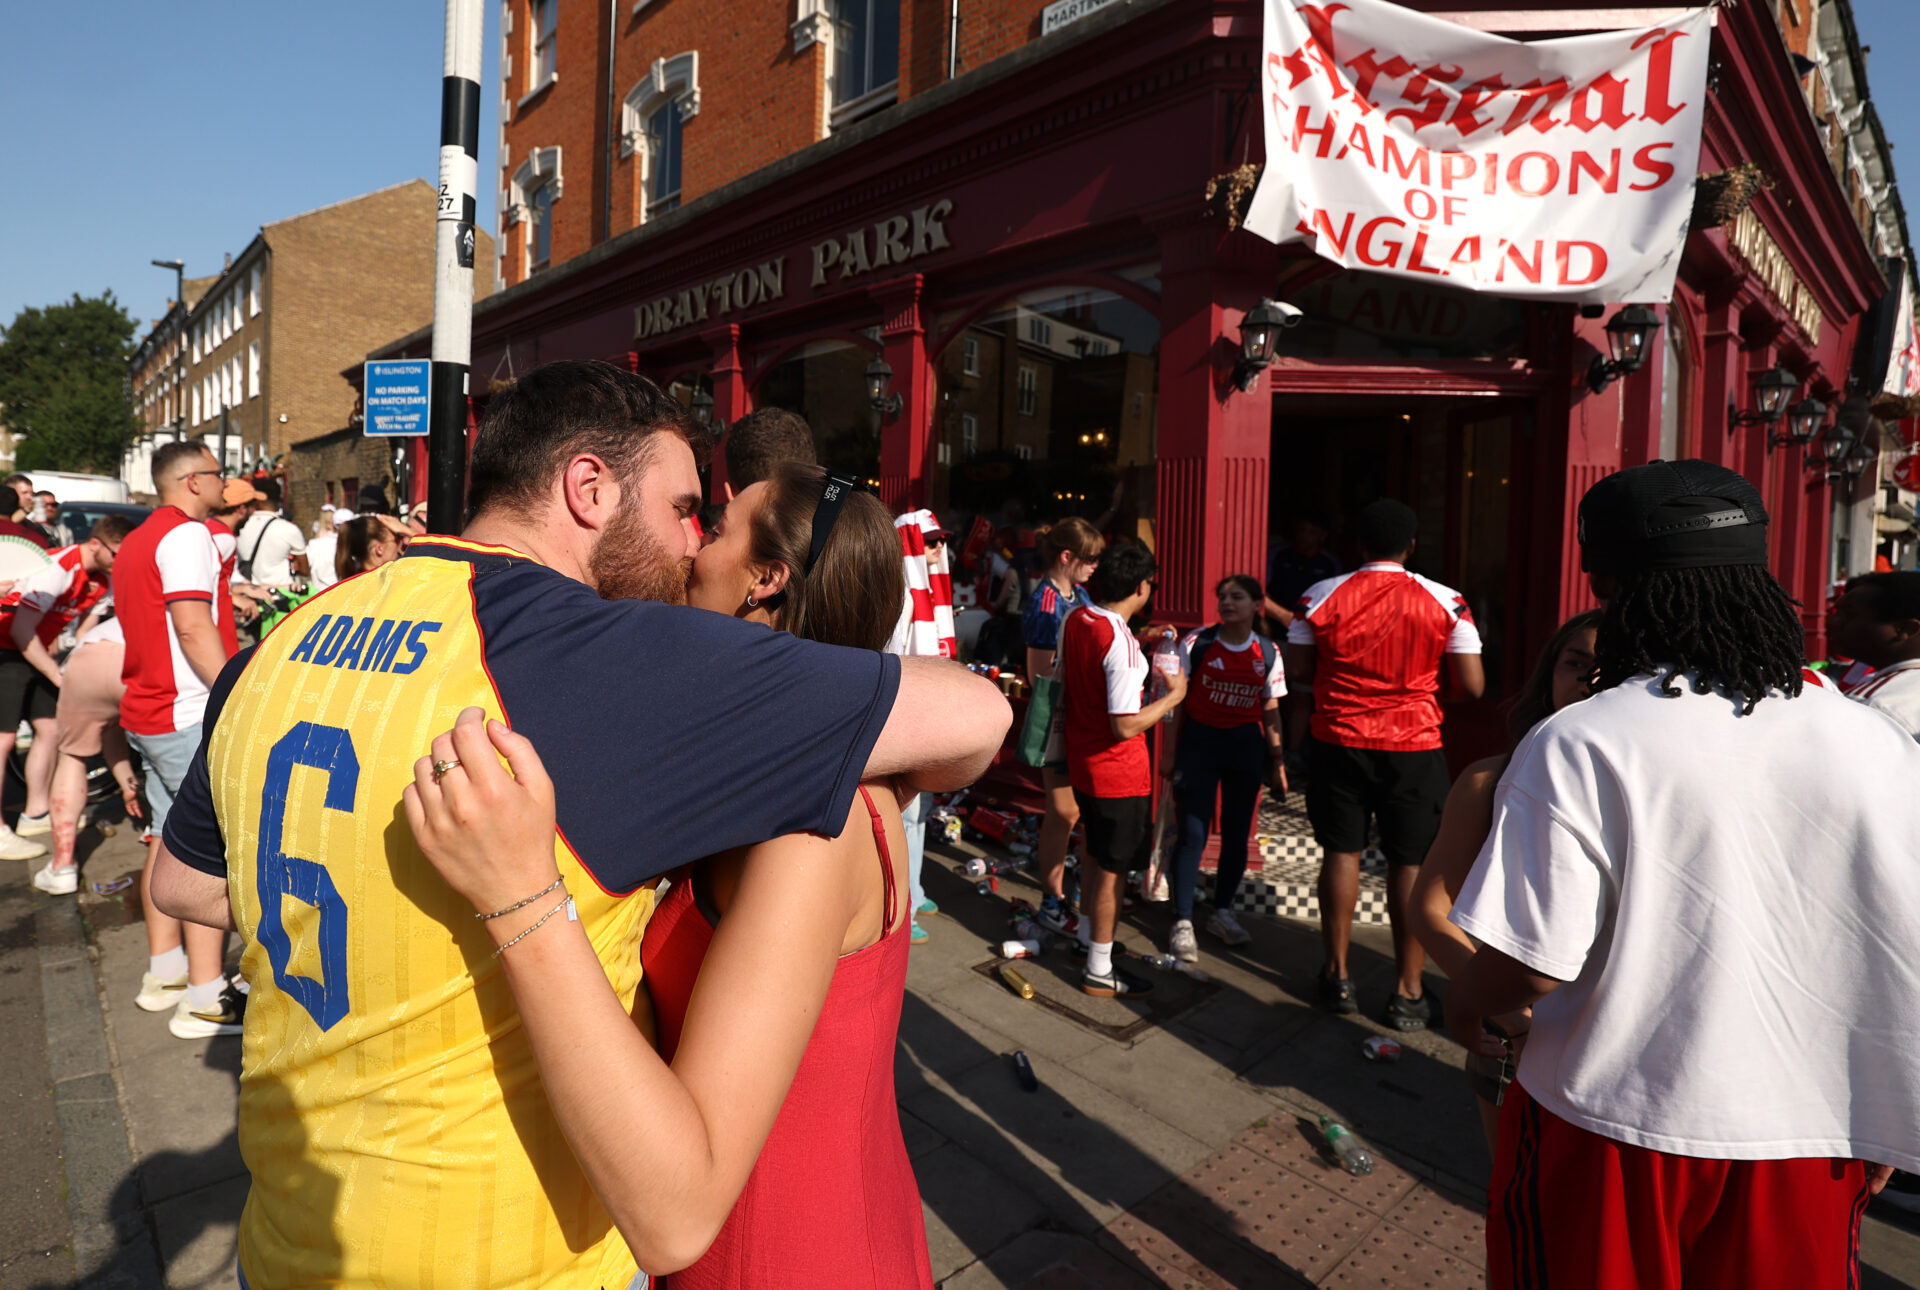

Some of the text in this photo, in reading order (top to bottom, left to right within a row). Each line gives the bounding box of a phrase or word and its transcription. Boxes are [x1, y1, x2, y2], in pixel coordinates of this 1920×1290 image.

[1268, 3, 1690, 137] Arsenal
[1404, 189, 1468, 226] OF
[633, 199, 953, 340] DRAYTON PARK
[382, 366, 422, 375] ISLINGTON
[368, 396, 427, 405] ON MATCH DAYS
[375, 386, 420, 395] NO PARKING
[289, 614, 442, 674] ADAMS
[1209, 690, 1226, 705] FLY
[257, 720, 360, 1033] 6
